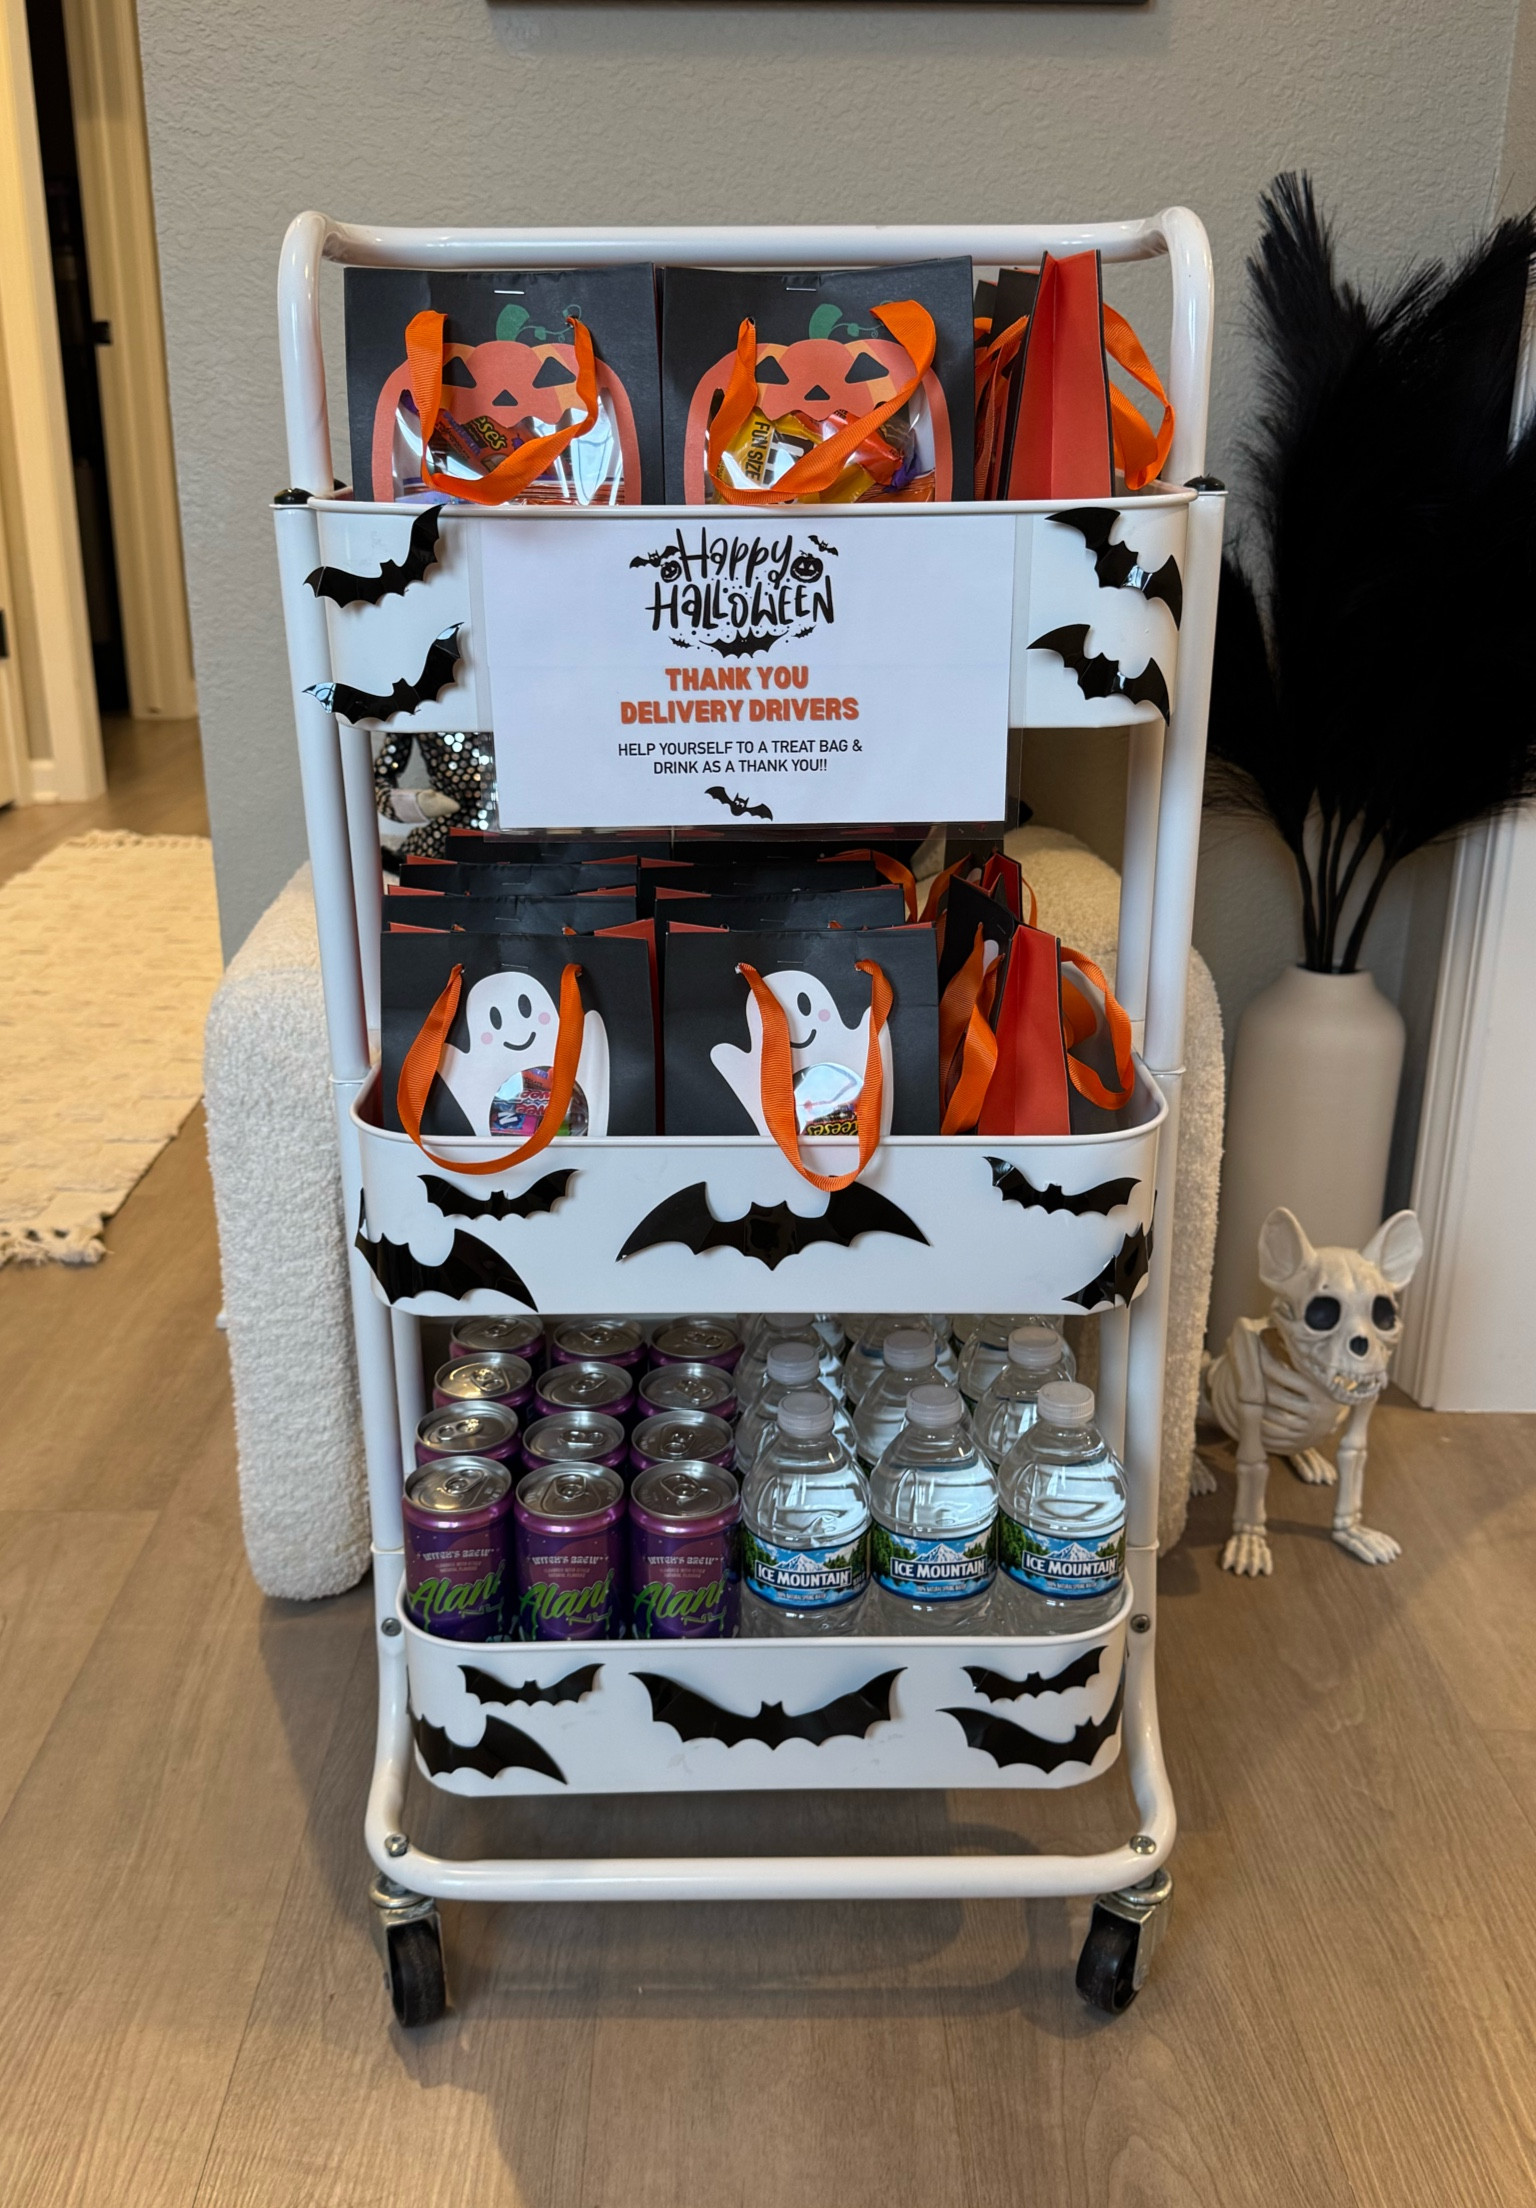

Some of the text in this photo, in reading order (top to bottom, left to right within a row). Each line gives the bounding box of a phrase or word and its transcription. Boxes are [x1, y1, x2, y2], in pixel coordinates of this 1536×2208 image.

[744, 421, 770, 481] FUN SIZE
[675, 526, 793, 590] Happy
[665, 666, 809, 691] THANK YOU
[620, 697, 860, 724] DELIVERY DRIVERS
[618, 739, 863, 756] HELP YOURSELF TO A TREAT BAG &
[654, 759, 828, 774] DRINK AS A THANK YOU!!
[758, 1563, 775, 1582] ICE
[777, 1570, 850, 1587] MOUNTAIN
[894, 1559, 986, 1578] ICE MOUNTAIN
[1025, 1554, 1118, 1576] ICE MOUNTAIN
